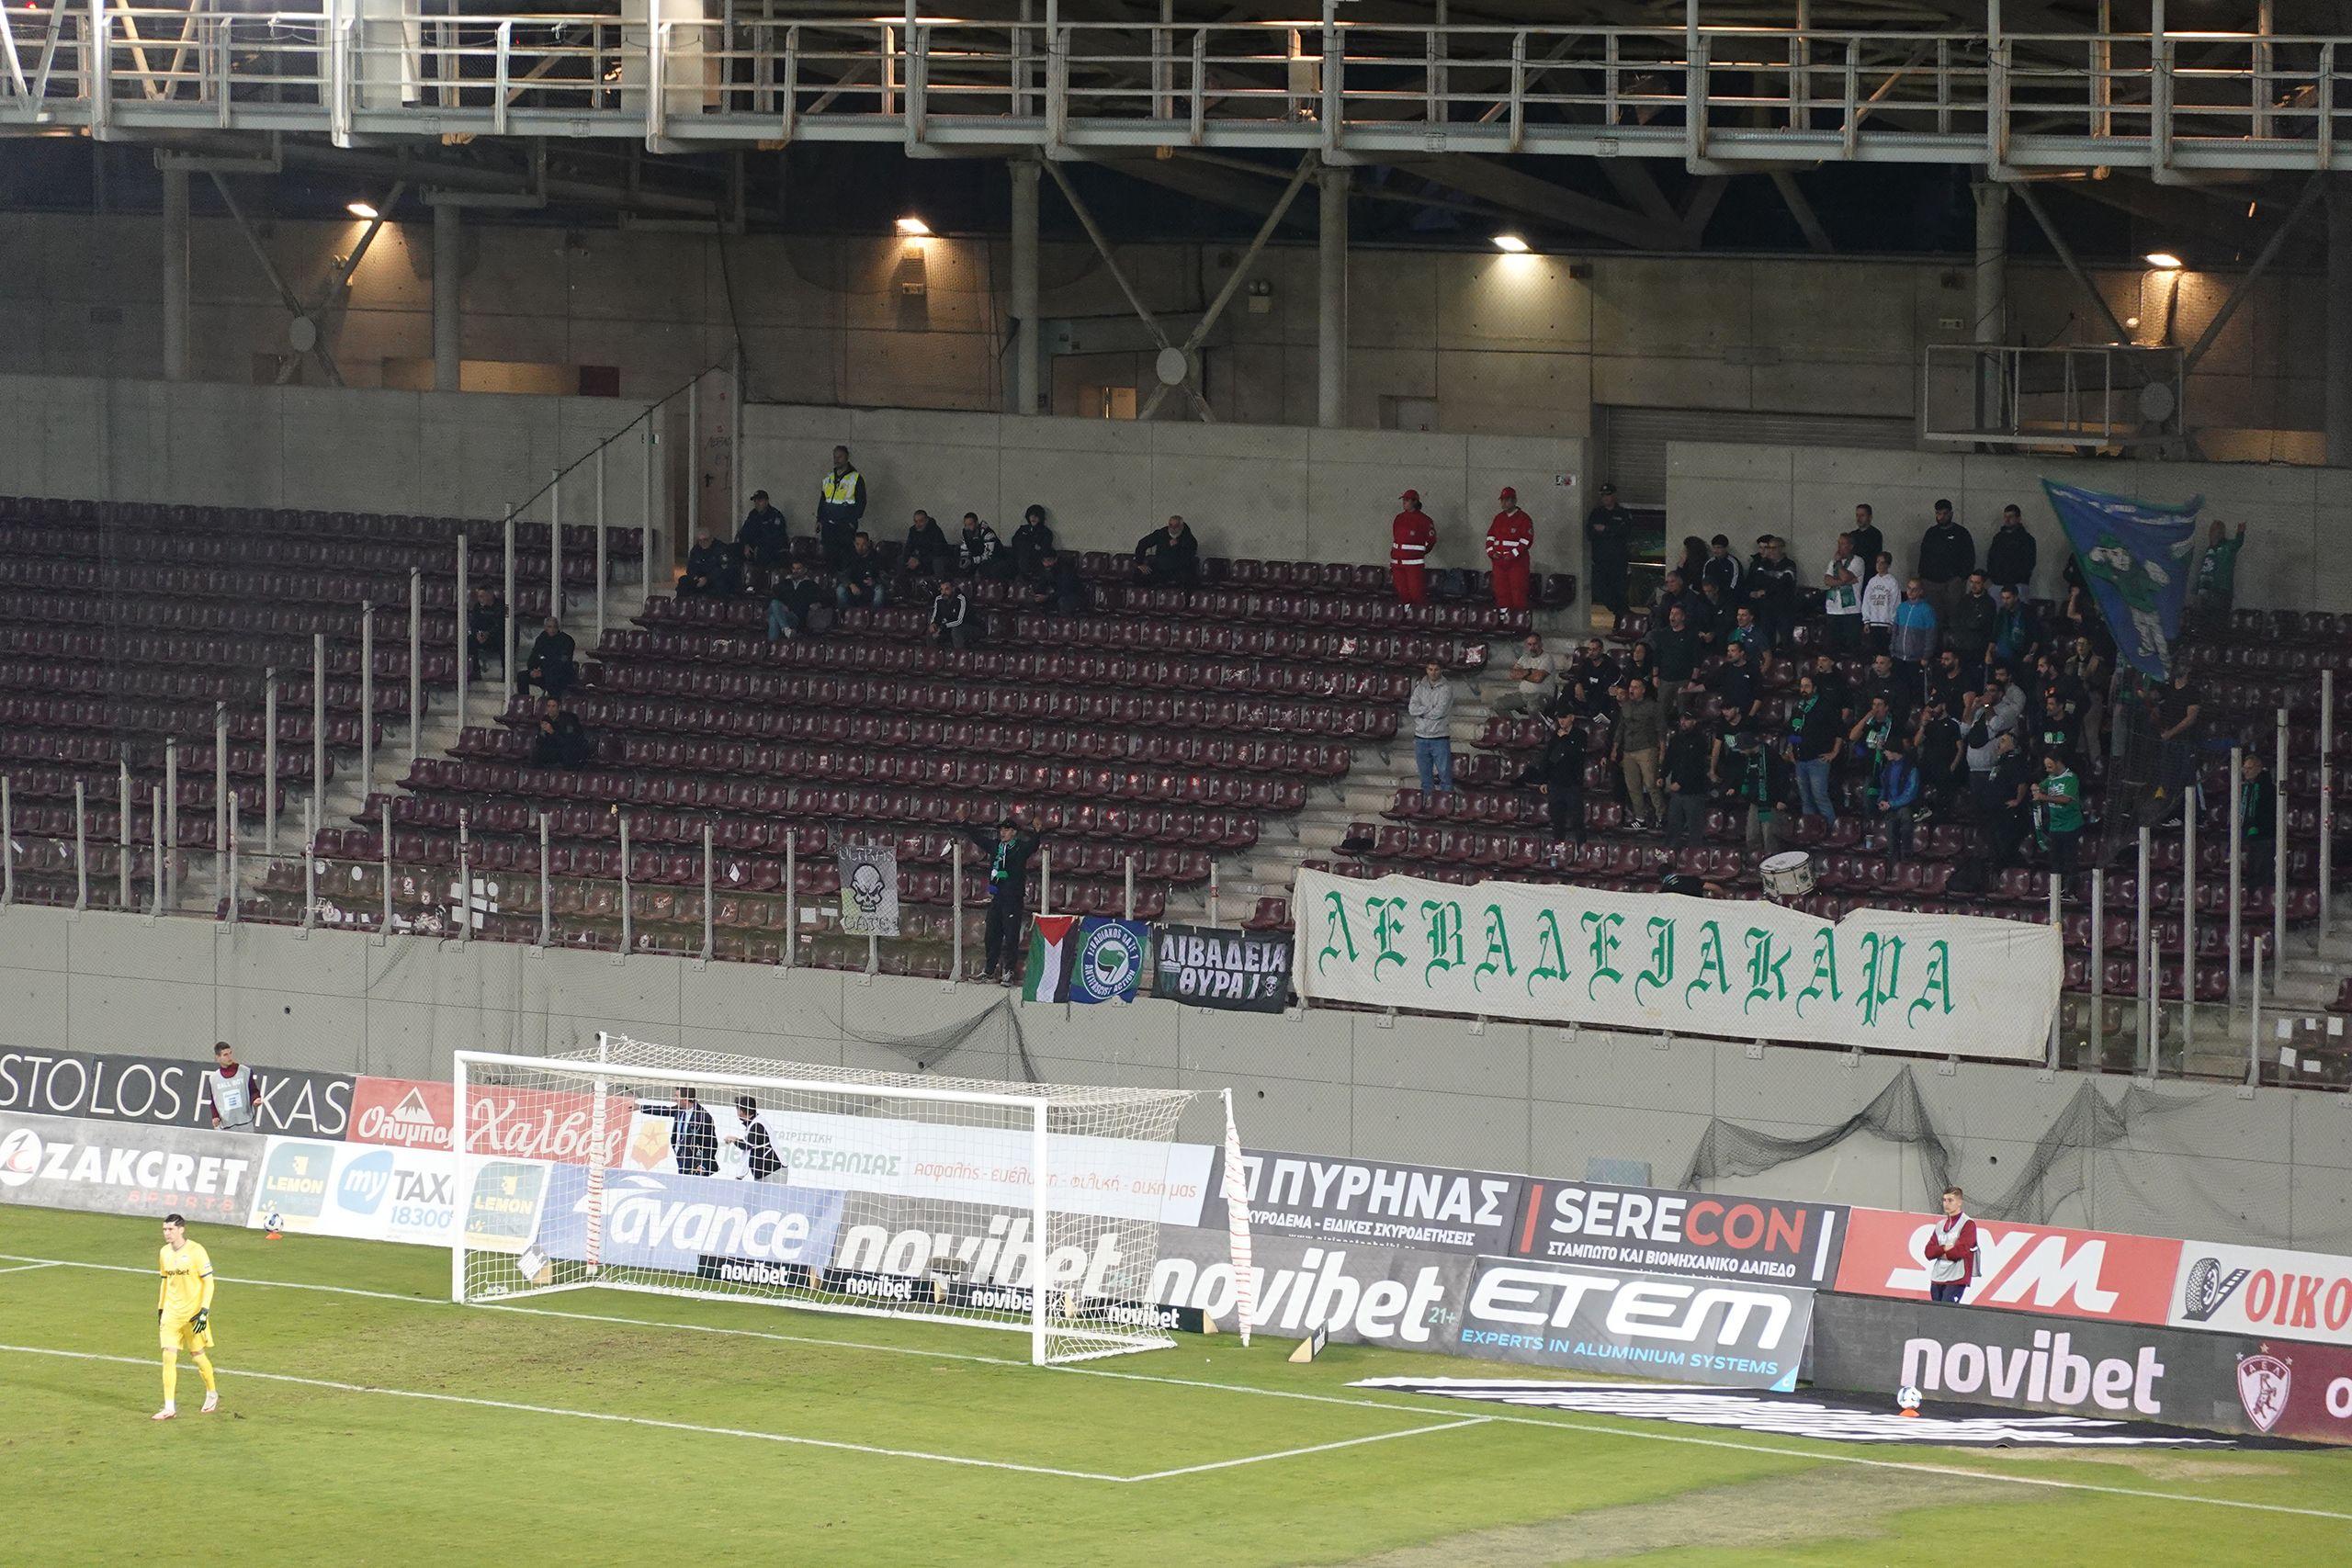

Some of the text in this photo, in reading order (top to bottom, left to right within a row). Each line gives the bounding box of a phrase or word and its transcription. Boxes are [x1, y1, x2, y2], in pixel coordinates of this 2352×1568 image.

[1160, 933, 1287, 973] ΛΙΒΑΔΕΙΑ
[1179, 967, 1245, 999] ΘΥΡΑ
[39, 1143, 249, 1197] ZAKCRET
[266, 1175, 324, 1195] LEMON
[344, 1168, 388, 1202] my
[474, 1195, 534, 1215] LEMON
[1268, 1159, 1510, 1227] ΠΥΡΗΝΑΣ
[390, 1205, 451, 1229] 18300
[609, 1194, 810, 1260] avance
[1247, 1210, 1312, 1229] ΚΥΡΟΔΕΜΑ
[1322, 1218, 1374, 1236] ΕΙΔΙΚΕΣ
[1373, 1223, 1476, 1247] ΣΚΥΡΟΔΕΤΗΣΕΙΣ
[1550, 1187, 1807, 1254] SERECON
[720, 1261, 789, 1286] novibet
[835, 1214, 1123, 1299] novibet
[1619, 1247, 1645, 1264] ΚΑΙ
[1645, 1250, 1738, 1273] ΒΙΟΜΗΧΑΝΙΚΟ
[1739, 1258, 1796, 1279] ΔΑΠΕΔΟ
[1885, 1223, 2120, 1314] SYM
[845, 1274, 911, 1302] novibet
[971, 1289, 1034, 1314] novibe
[1148, 1247, 1447, 1344] novibet
[1429, 1305, 1456, 1325] 21+
[1108, 1302, 1181, 1330] novibet
[1468, 1266, 1792, 1350] ETEM
[1461, 1329, 1780, 1376] EXPERTS IN ALUMINIUM SYSTEMS
[1900, 1328, 2165, 1416] novibet
